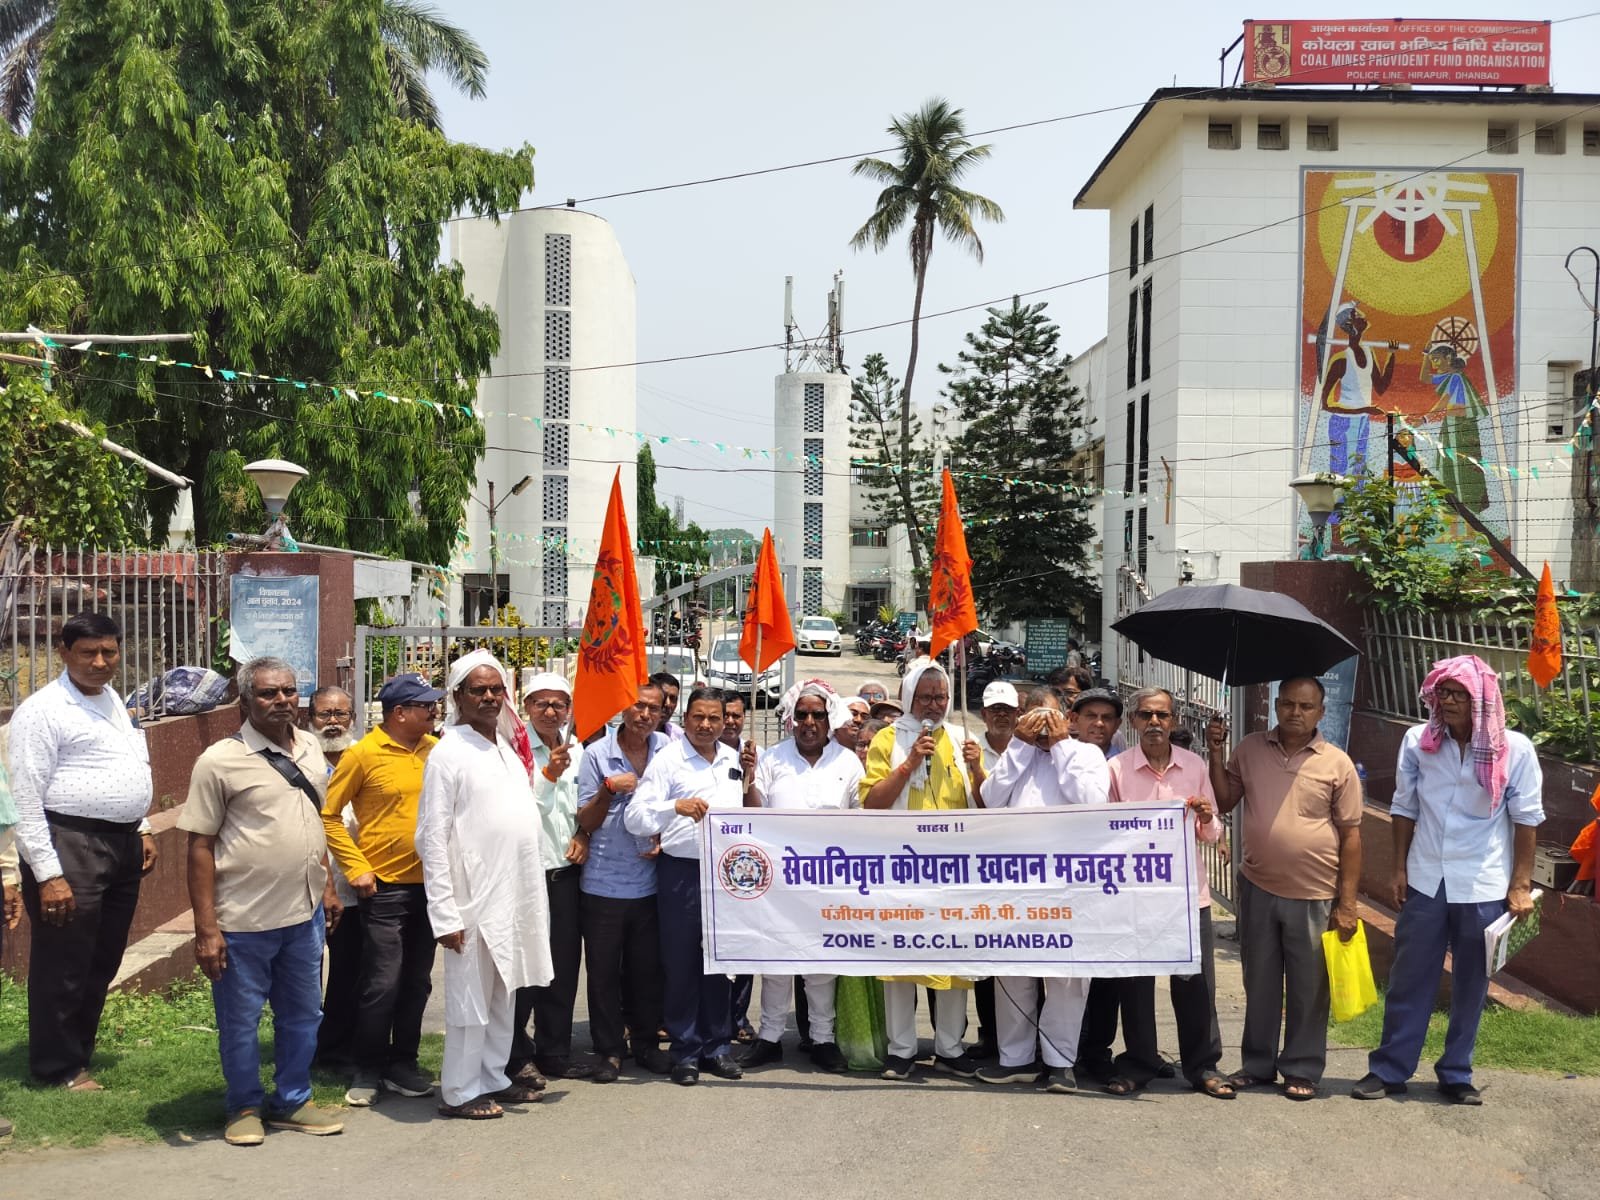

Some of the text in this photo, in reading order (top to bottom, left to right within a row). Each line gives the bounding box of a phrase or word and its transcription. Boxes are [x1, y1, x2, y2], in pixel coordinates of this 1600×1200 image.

[1400, 25, 1432, 33] OFFICE
[1434, 25, 1446, 33] OF
[1451, 25, 1465, 33] THE
[1302, 37, 1355, 51] कोयला
[1360, 40, 1395, 51] खान
[1452, 36, 1488, 51] निधि
[1492, 38, 1544, 53] संगठन
[1300, 54, 1545, 68] COAL MINES PROVIDENT FUND ORGANISATION
[1346, 71, 1380, 80] POLICE
[1455, 71, 1500, 80] DHANBAD
[281, 598, 302, 606] 2024
[720, 821, 752, 834] सेवा !
[954, 822, 964, 833] !!
[1109, 817, 1174, 830] समर्पण !!!
[890, 845, 970, 885] कोयला
[976, 854, 1047, 883] खदान
[1053, 854, 1127, 895] मजदूर
[1132, 843, 1173, 883] संघ
[821, 904, 875, 921] पंजीयन
[879, 904, 925, 921] क्रमांक
[1026, 907, 1073, 920] 5695
[822, 934, 875, 948] ZONE
[893, 934, 968, 949] B.C.C.L.
[974, 934, 1074, 949] DHANBAD
